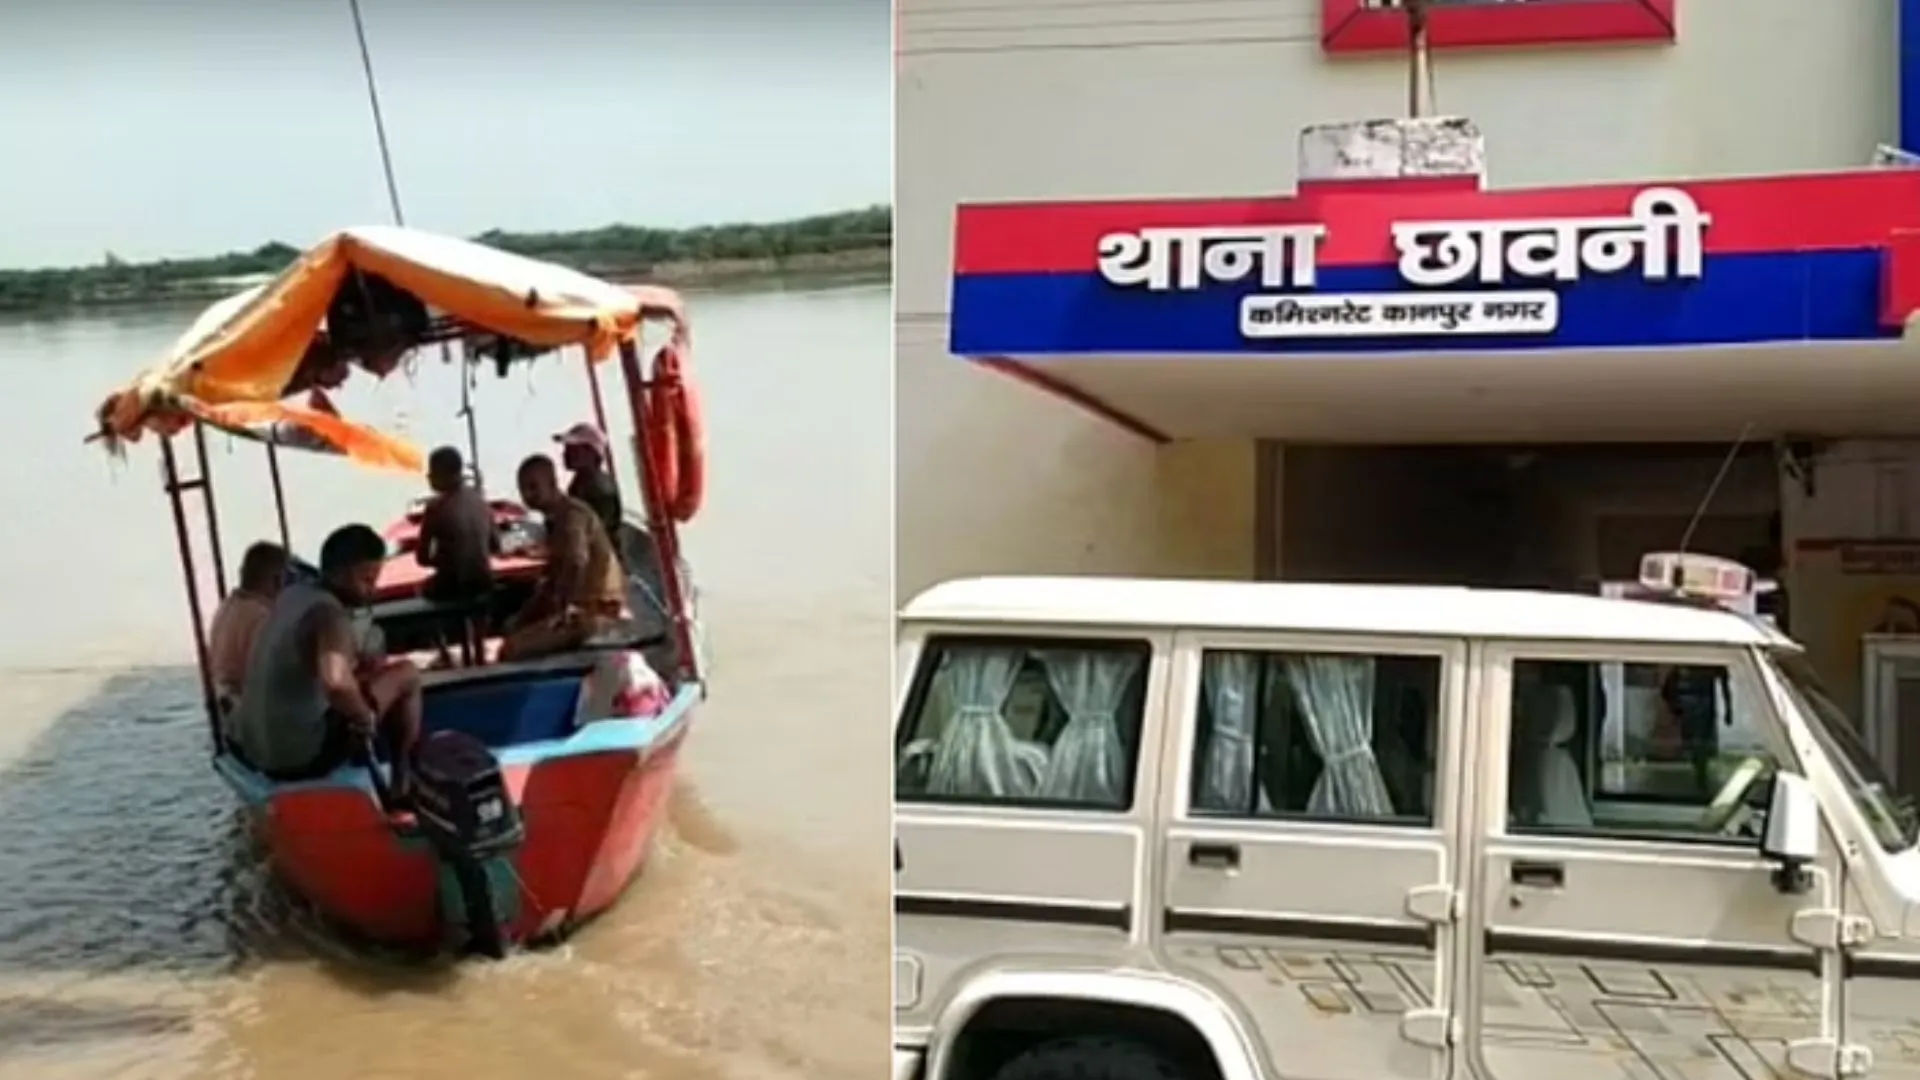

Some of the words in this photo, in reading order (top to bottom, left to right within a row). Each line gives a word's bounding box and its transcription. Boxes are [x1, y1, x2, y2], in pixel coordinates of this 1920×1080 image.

[1098, 224, 1326, 290] थाना
[1392, 188, 1711, 284] छावनी
[1381, 301, 1474, 330] कानपुर
[1482, 301, 1546, 321] नगर
